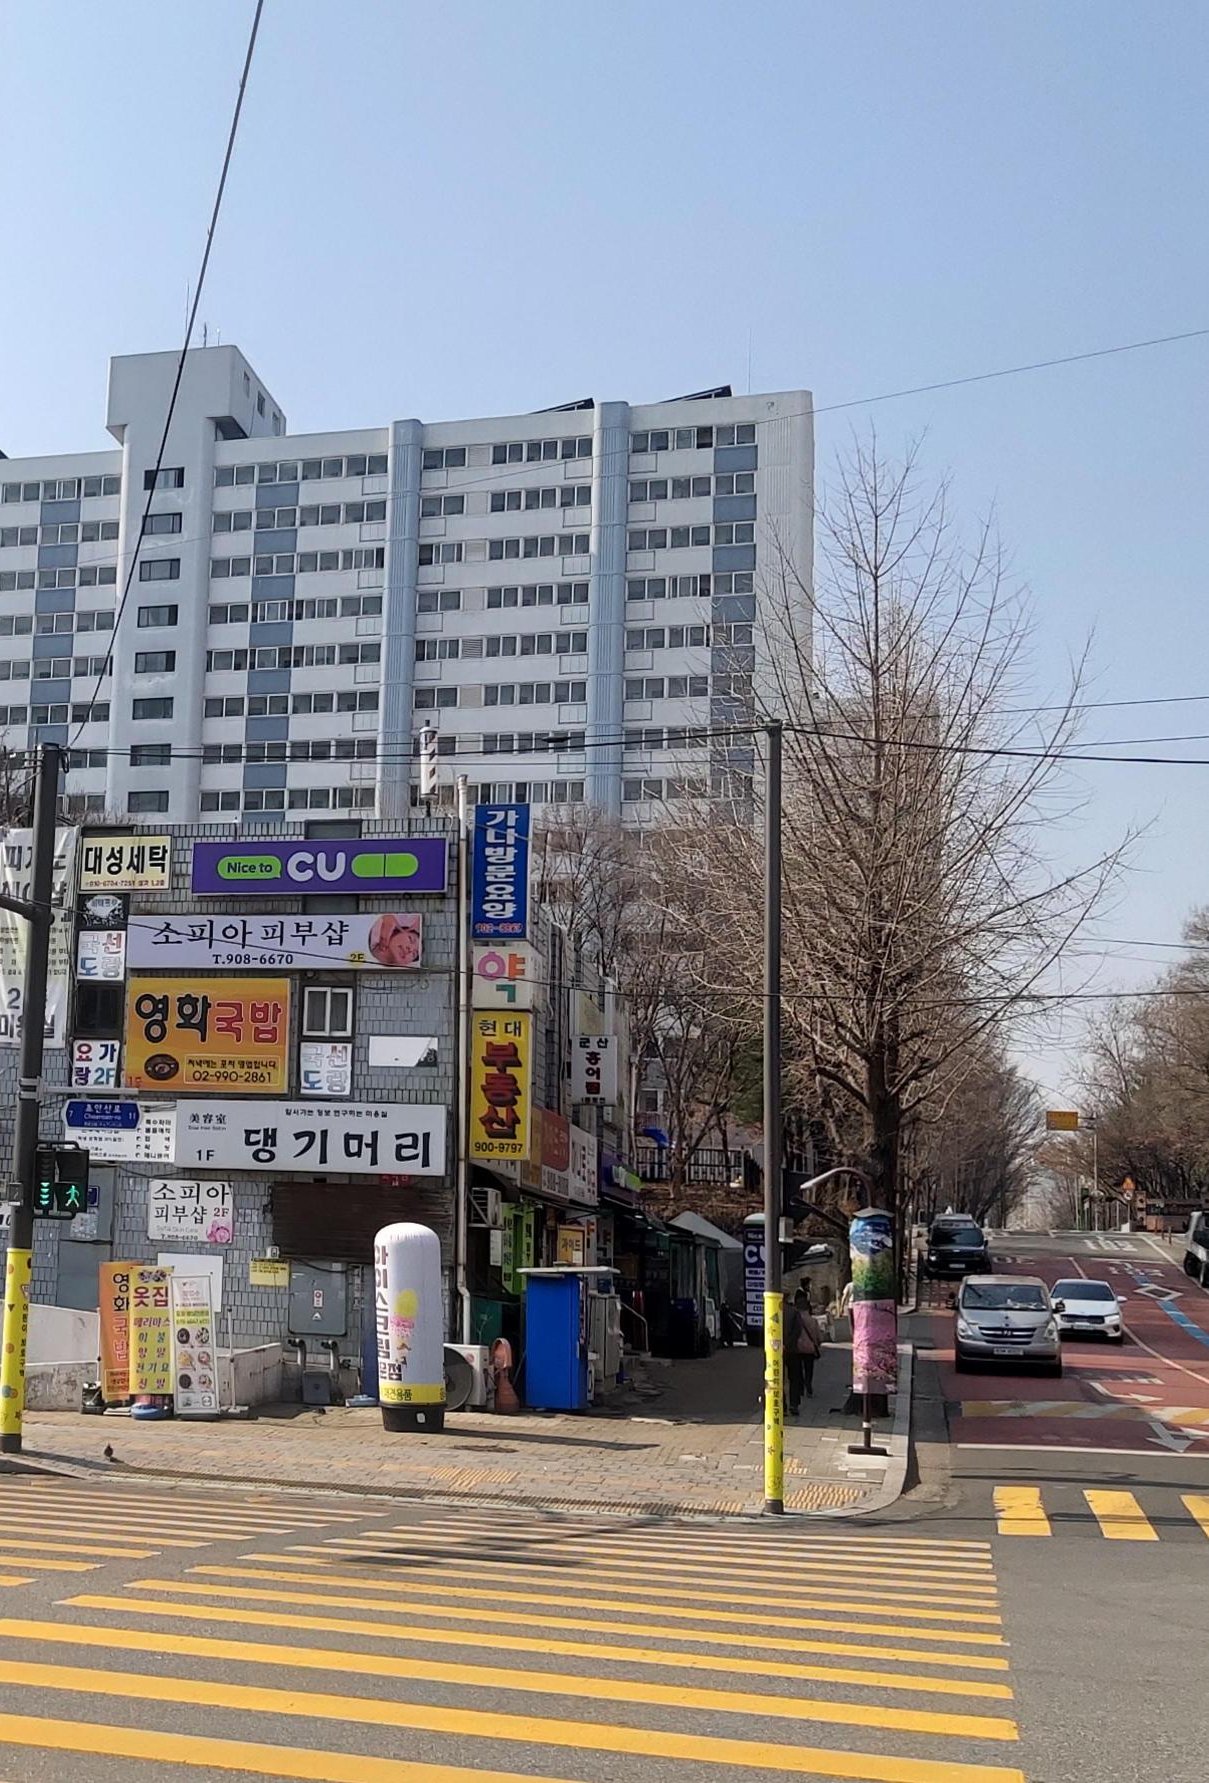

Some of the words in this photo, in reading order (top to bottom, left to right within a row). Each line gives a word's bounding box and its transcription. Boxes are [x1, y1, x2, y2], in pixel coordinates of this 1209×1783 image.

[85, 845, 168, 876] 대성세탁
[226, 861, 255, 873] Nice
[258, 862, 273, 873] to
[287, 851, 346, 882] CU
[482, 810, 519, 919] 가나방문요양
[151, 918, 252, 949] 소피아
[260, 919, 350, 948] 피부샵
[212, 953, 294, 965] T.908-6670
[478, 951, 526, 1003] 약
[134, 992, 284, 1045] 영화국밥
[478, 1019, 522, 1037] 현대
[76, 1043, 117, 1062] 요가
[93, 1067, 116, 1085] 2F
[192, 1070, 272, 1083] 02-990-2861
[190, 1113, 227, 1125] 美容室
[196, 1149, 216, 1162] 1F
[243, 1127, 431, 1169] 댕기머리
[152, 1182, 230, 1206] 소피아
[154, 1204, 208, 1225] 피부샵
[213, 1207, 230, 1218] 2F
[133, 1286, 169, 1308] 옷집
